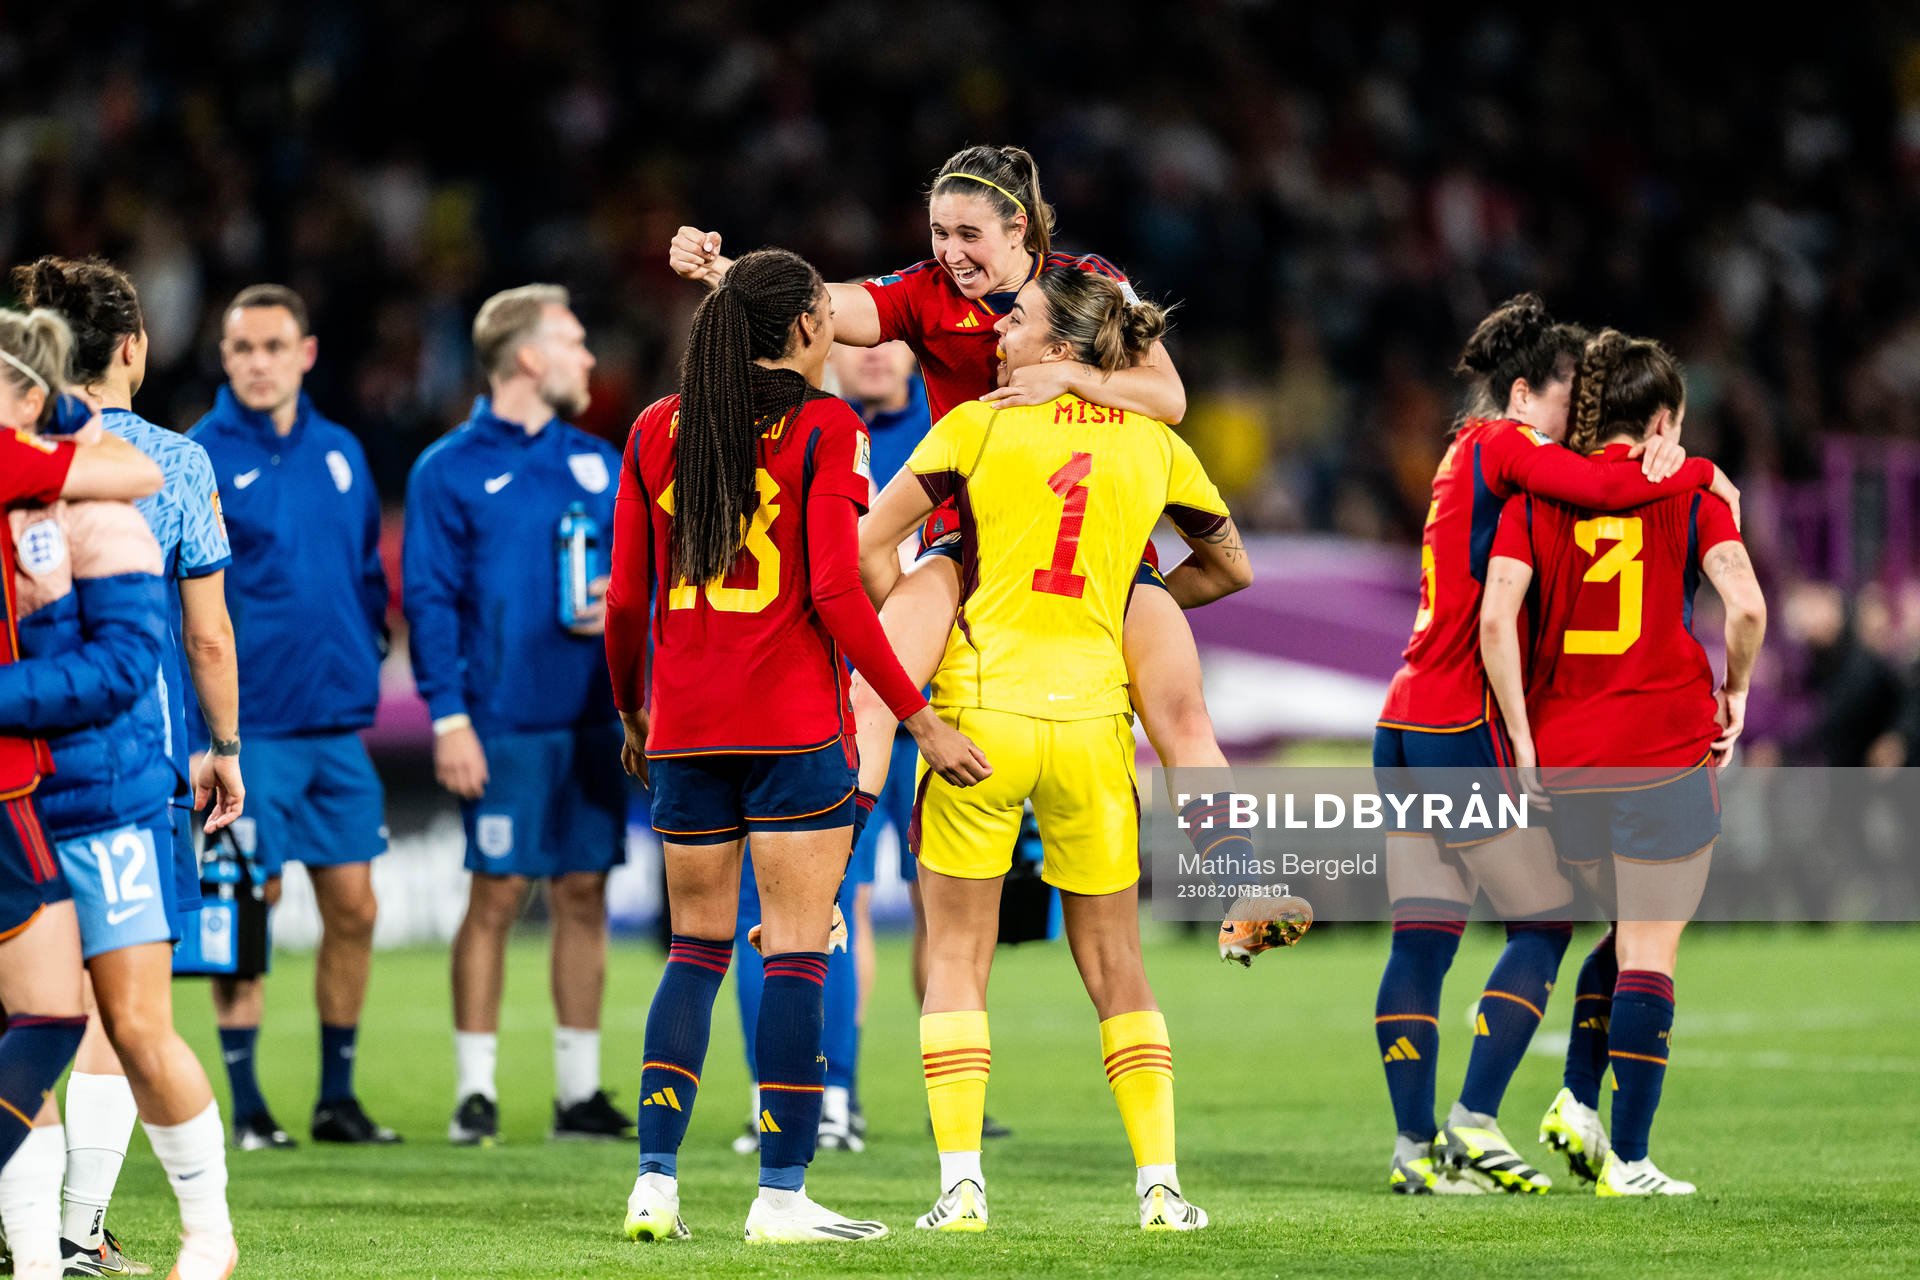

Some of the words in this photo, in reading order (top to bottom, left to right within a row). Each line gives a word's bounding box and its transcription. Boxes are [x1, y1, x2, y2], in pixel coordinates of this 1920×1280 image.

[1054, 401, 1125, 425] MISA
[1032, 451, 1093, 599] 1
[1563, 516, 1644, 655] 3
[91, 833, 154, 904] 12
